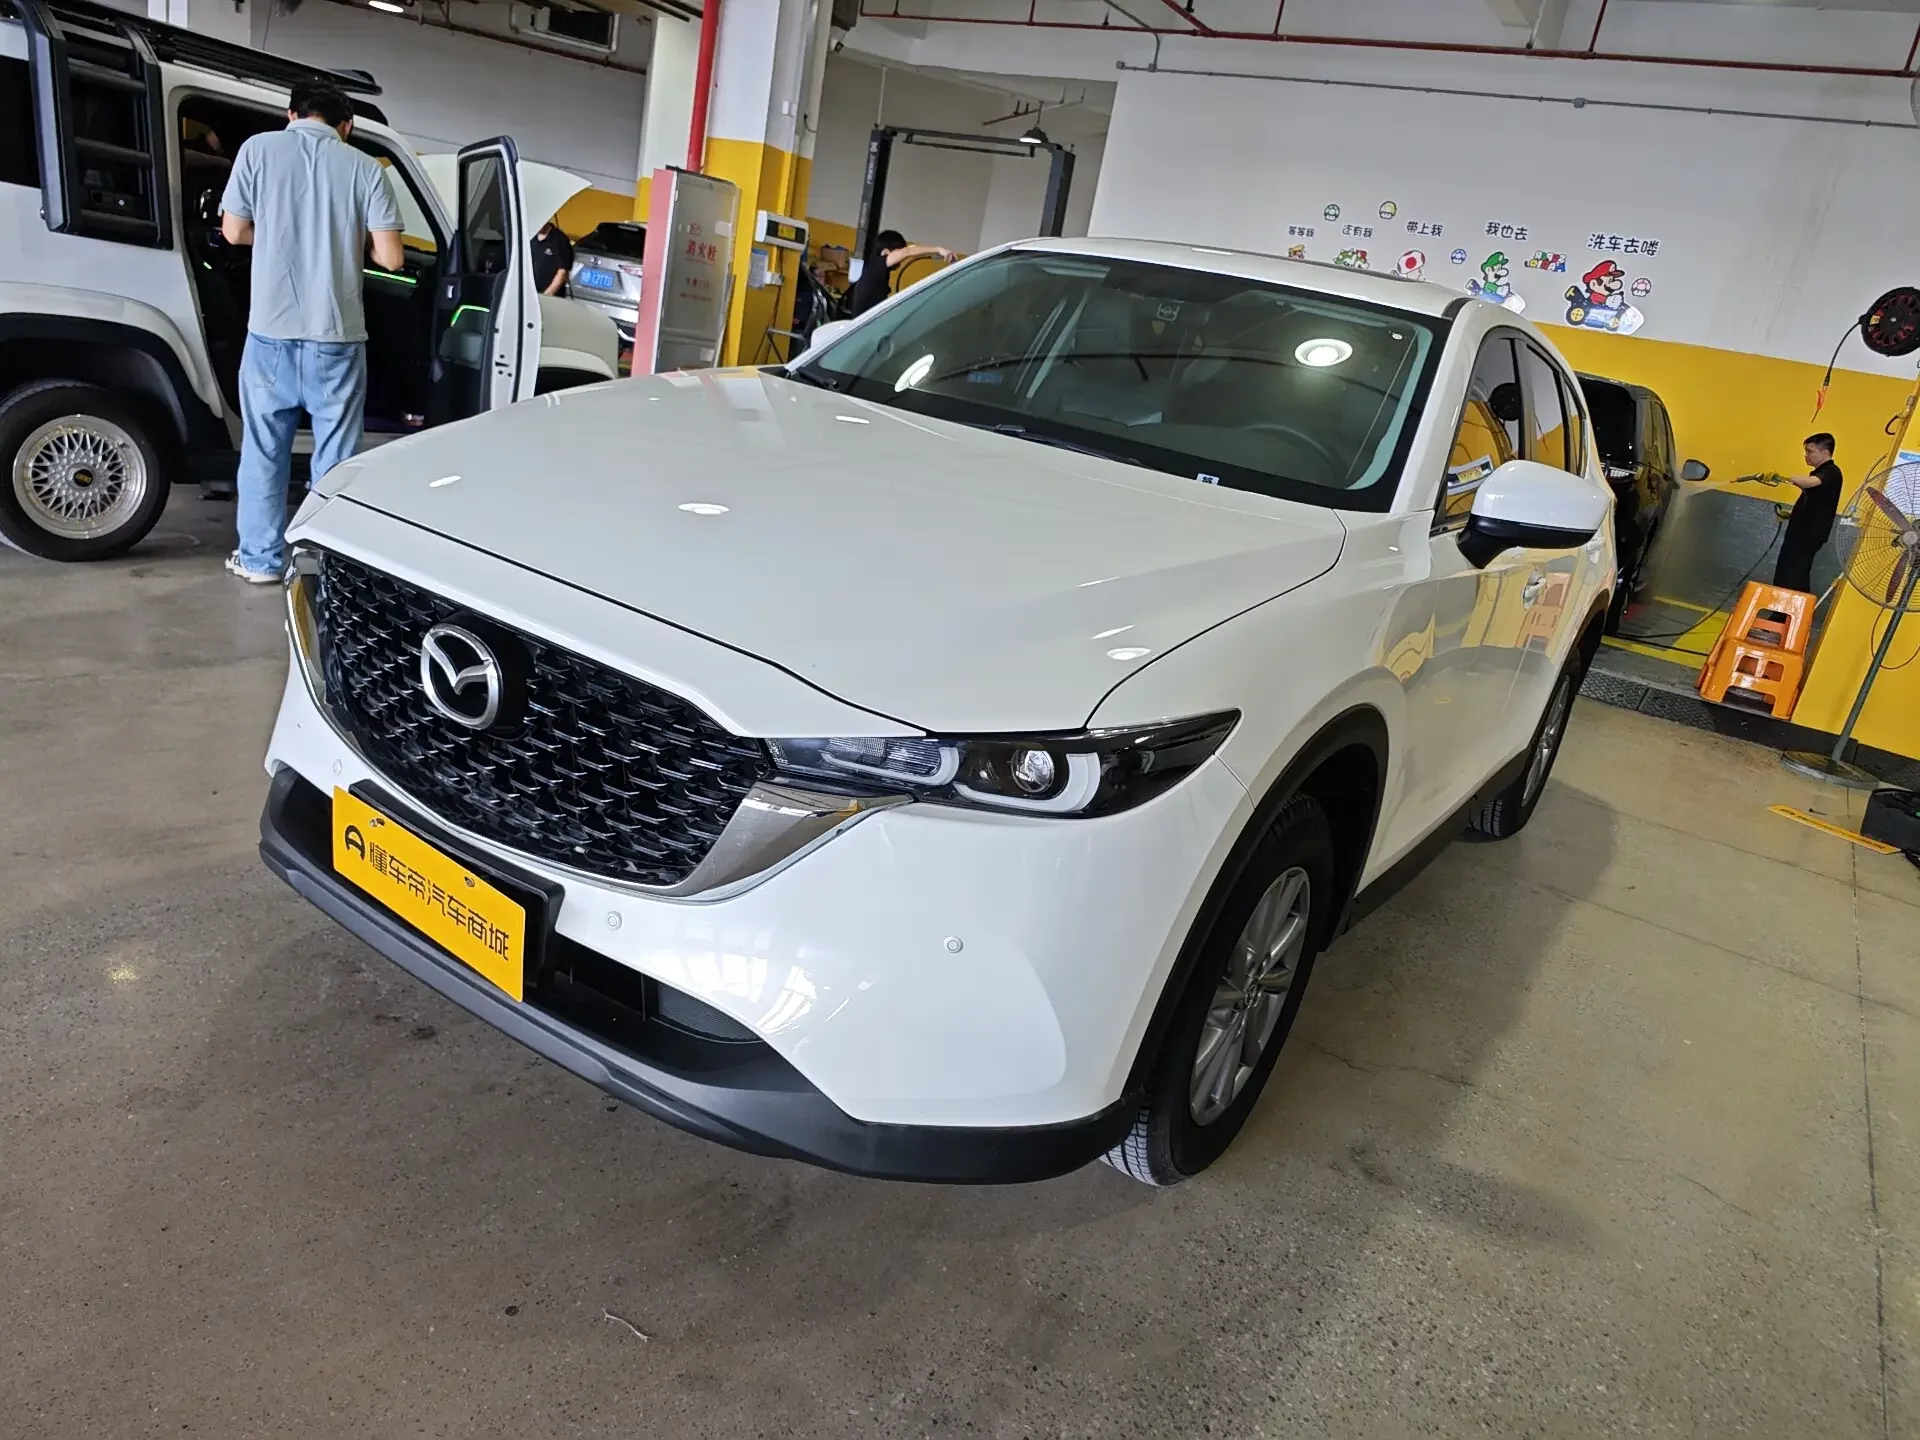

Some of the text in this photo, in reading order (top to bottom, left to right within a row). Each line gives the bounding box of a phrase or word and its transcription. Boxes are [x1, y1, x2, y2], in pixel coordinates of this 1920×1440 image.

[1288, 226, 1315, 238] 等等我
[1342, 224, 1374, 238] 还有我
[1406, 221, 1444, 237] 带上我
[1485, 221, 1528, 241] 我也去
[686, 239, 717, 261] 消火栓
[1587, 233, 1660, 257] 洗车去喽
[369, 841, 510, 962] 懂车帝汽车商城
